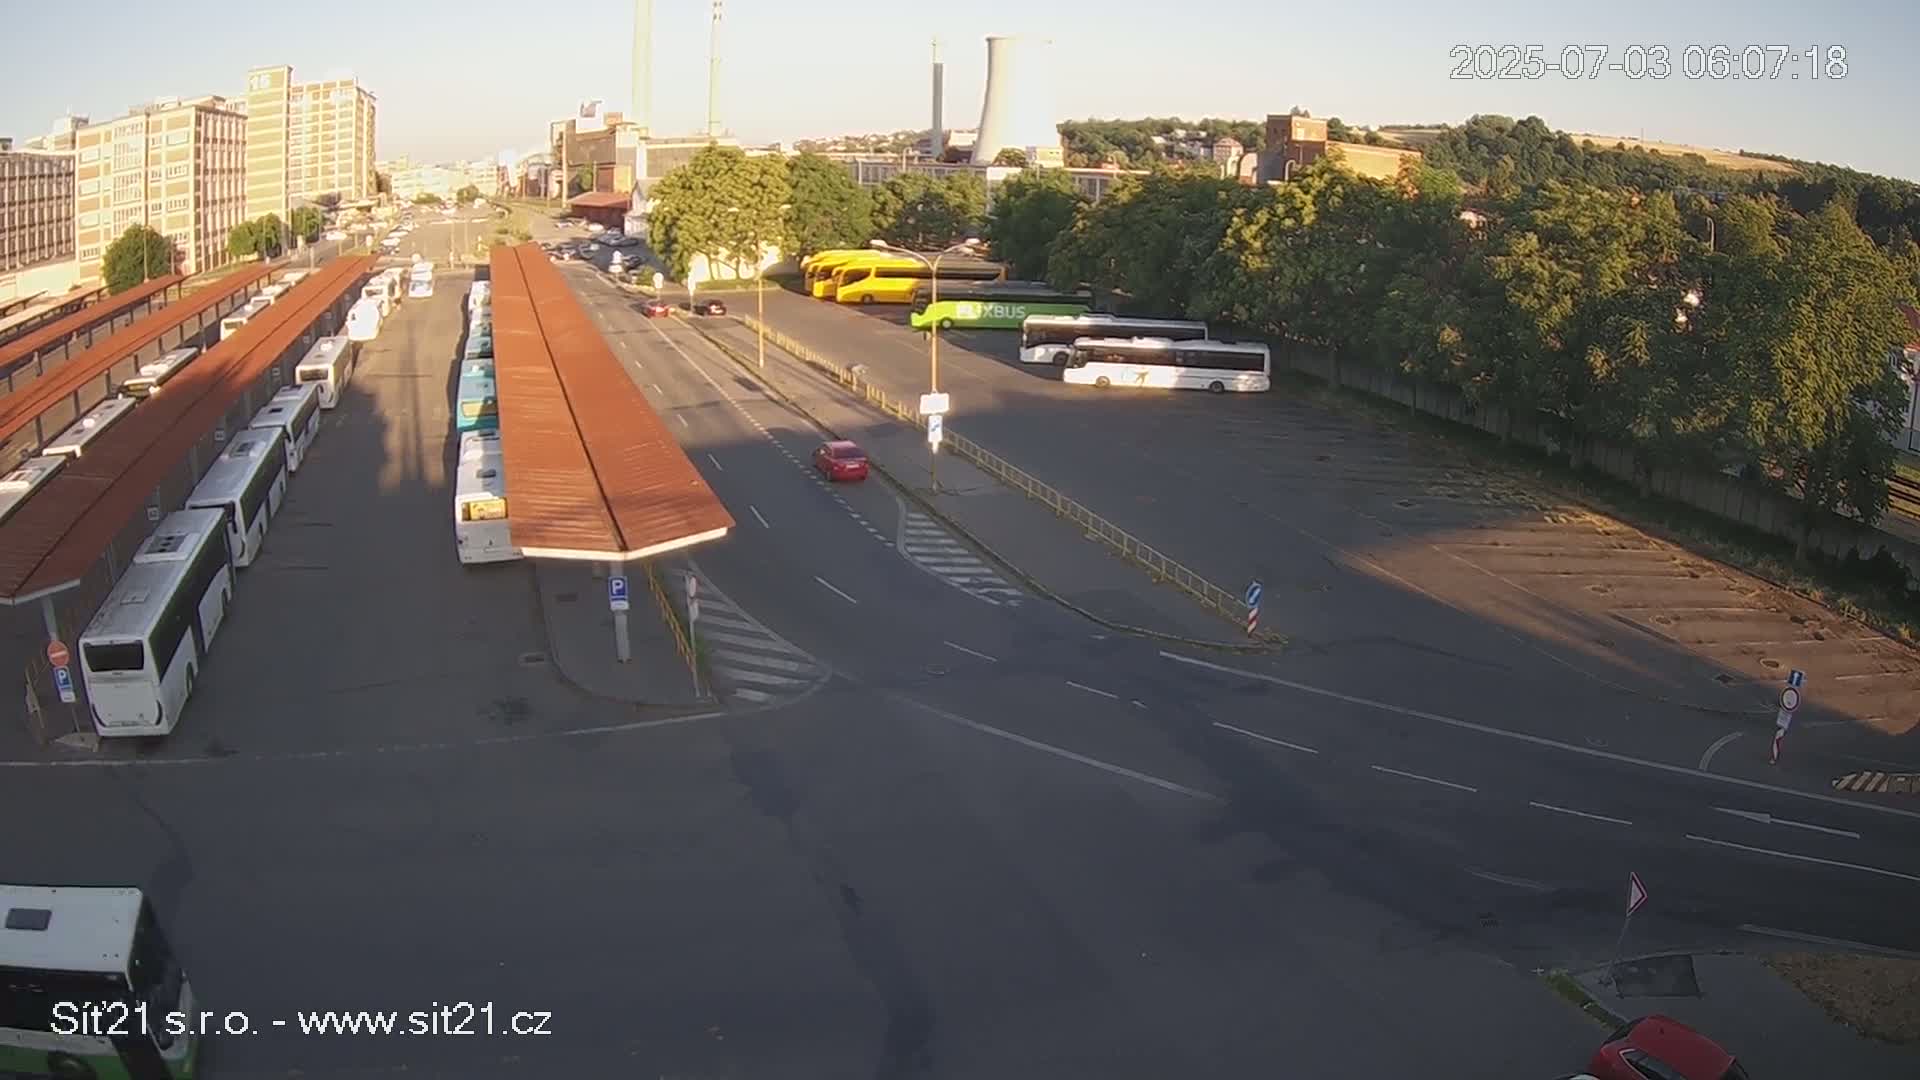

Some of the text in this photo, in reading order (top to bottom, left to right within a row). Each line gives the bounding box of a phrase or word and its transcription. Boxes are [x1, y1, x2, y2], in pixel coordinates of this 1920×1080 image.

[958, 304, 1025, 318] IXBUS
[612, 579, 624, 594] P
[58, 669, 67, 684] P
